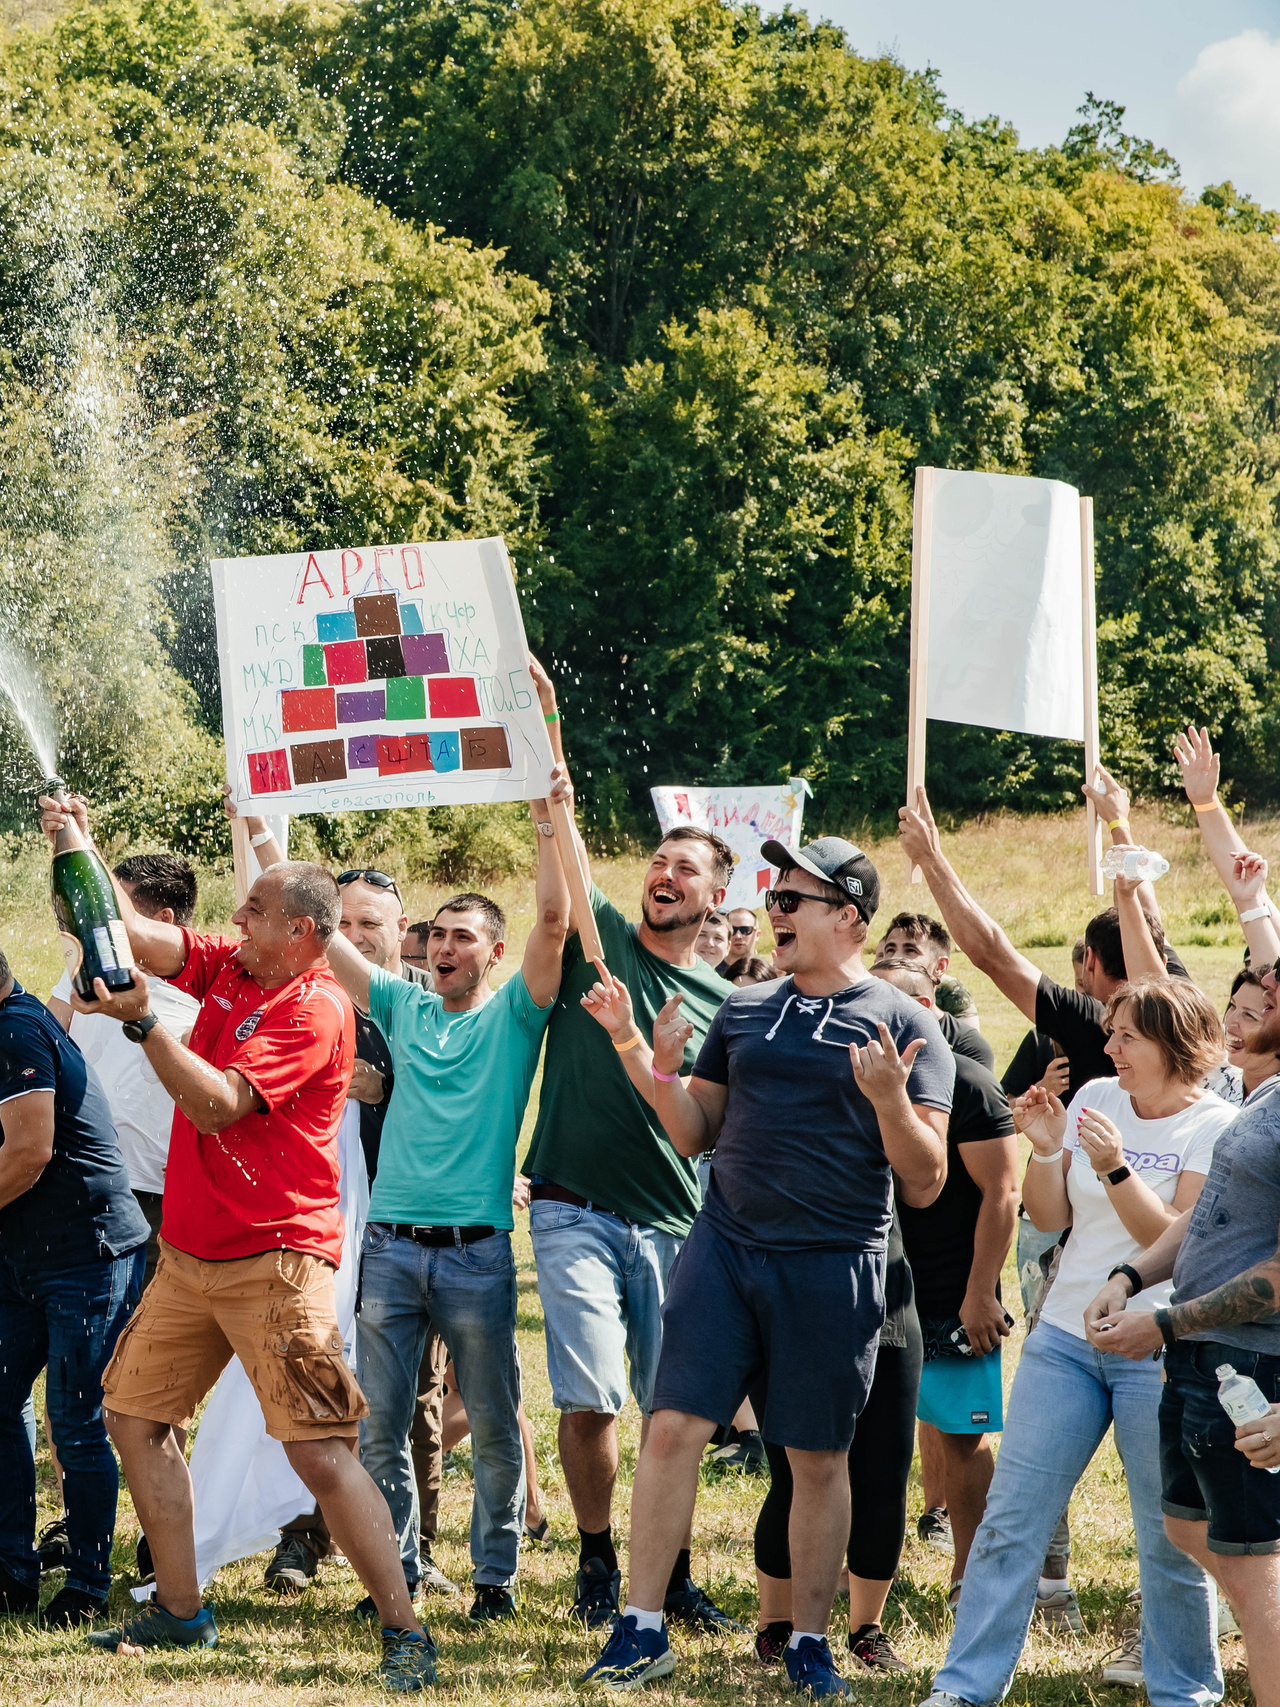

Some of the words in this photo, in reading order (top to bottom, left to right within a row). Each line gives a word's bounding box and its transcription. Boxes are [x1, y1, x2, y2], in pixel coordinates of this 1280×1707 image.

[297, 546, 425, 605] АРГО
[255, 620, 306, 648] ПСК
[453, 636, 491, 669] ХА
[242, 713, 278, 748] МК
[317, 787, 436, 809] Севастополь
